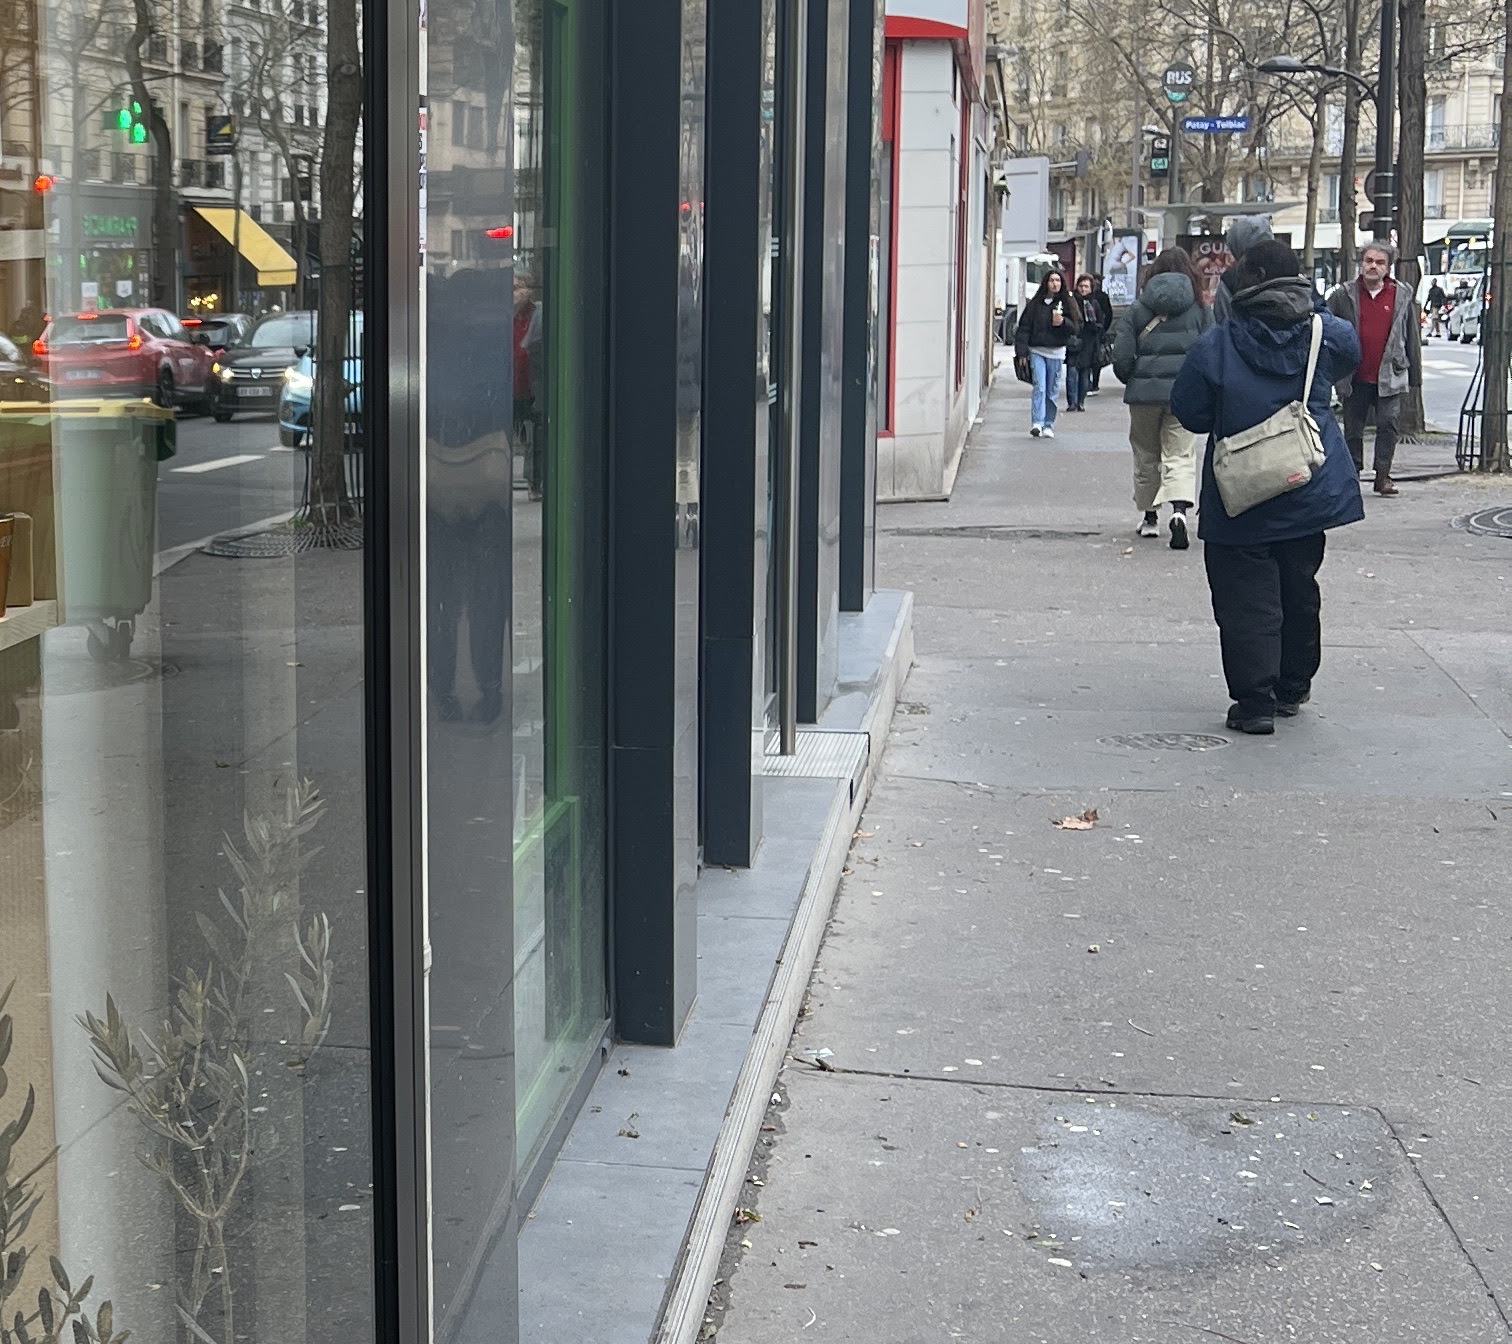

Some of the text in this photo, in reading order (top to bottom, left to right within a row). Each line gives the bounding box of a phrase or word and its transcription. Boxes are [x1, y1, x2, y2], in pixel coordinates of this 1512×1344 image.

[1166, 70, 1192, 85] BUS
[1185, 119, 1209, 130] Patay
[1216, 119, 1247, 130] Tolbiac
